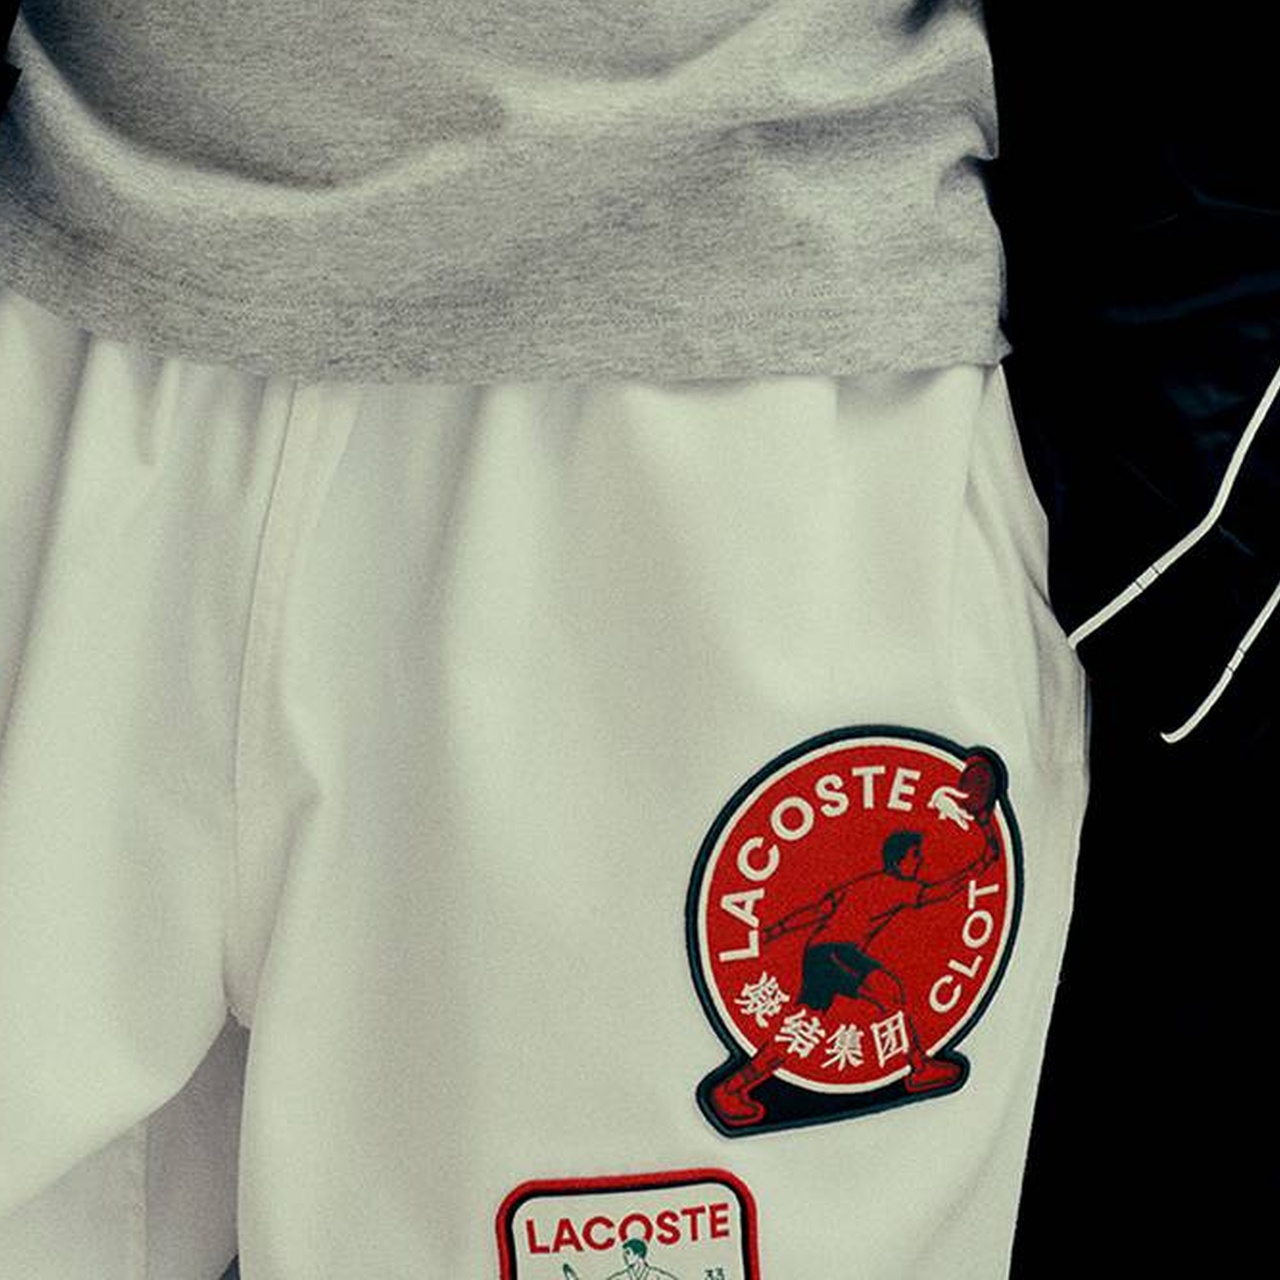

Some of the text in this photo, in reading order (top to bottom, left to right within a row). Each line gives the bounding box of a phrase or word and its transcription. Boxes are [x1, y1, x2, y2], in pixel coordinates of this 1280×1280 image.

[719, 765, 921, 962] LACOSTE
[928, 880, 1000, 1014] CLOT
[525, 1202, 731, 1254] LACOSTE
